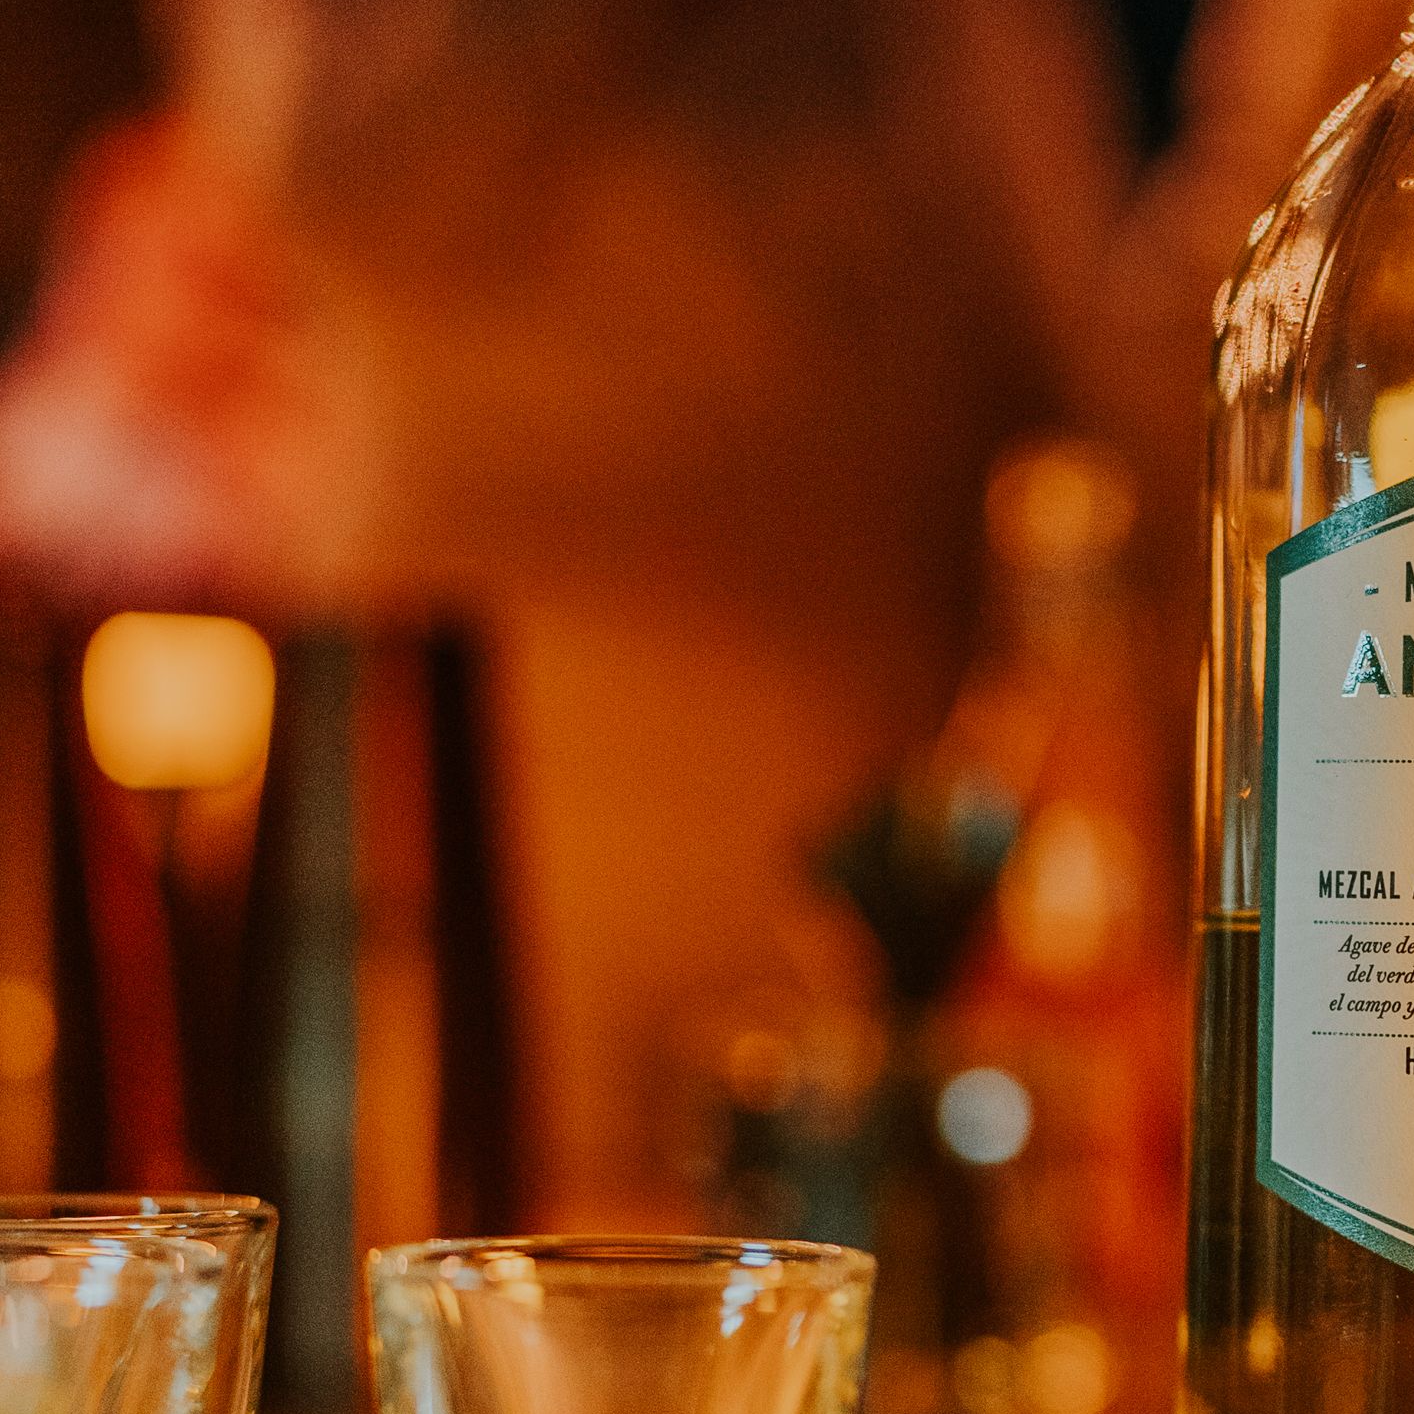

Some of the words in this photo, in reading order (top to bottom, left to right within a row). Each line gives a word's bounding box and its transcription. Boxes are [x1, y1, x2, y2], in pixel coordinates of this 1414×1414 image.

[1318, 869, 1400, 900] MEZCAL
[1338, 935, 1391, 960] Agave
[1347, 964, 1372, 983] del
[1329, 993, 1345, 1012] el
[1347, 997, 1401, 1018] campo
